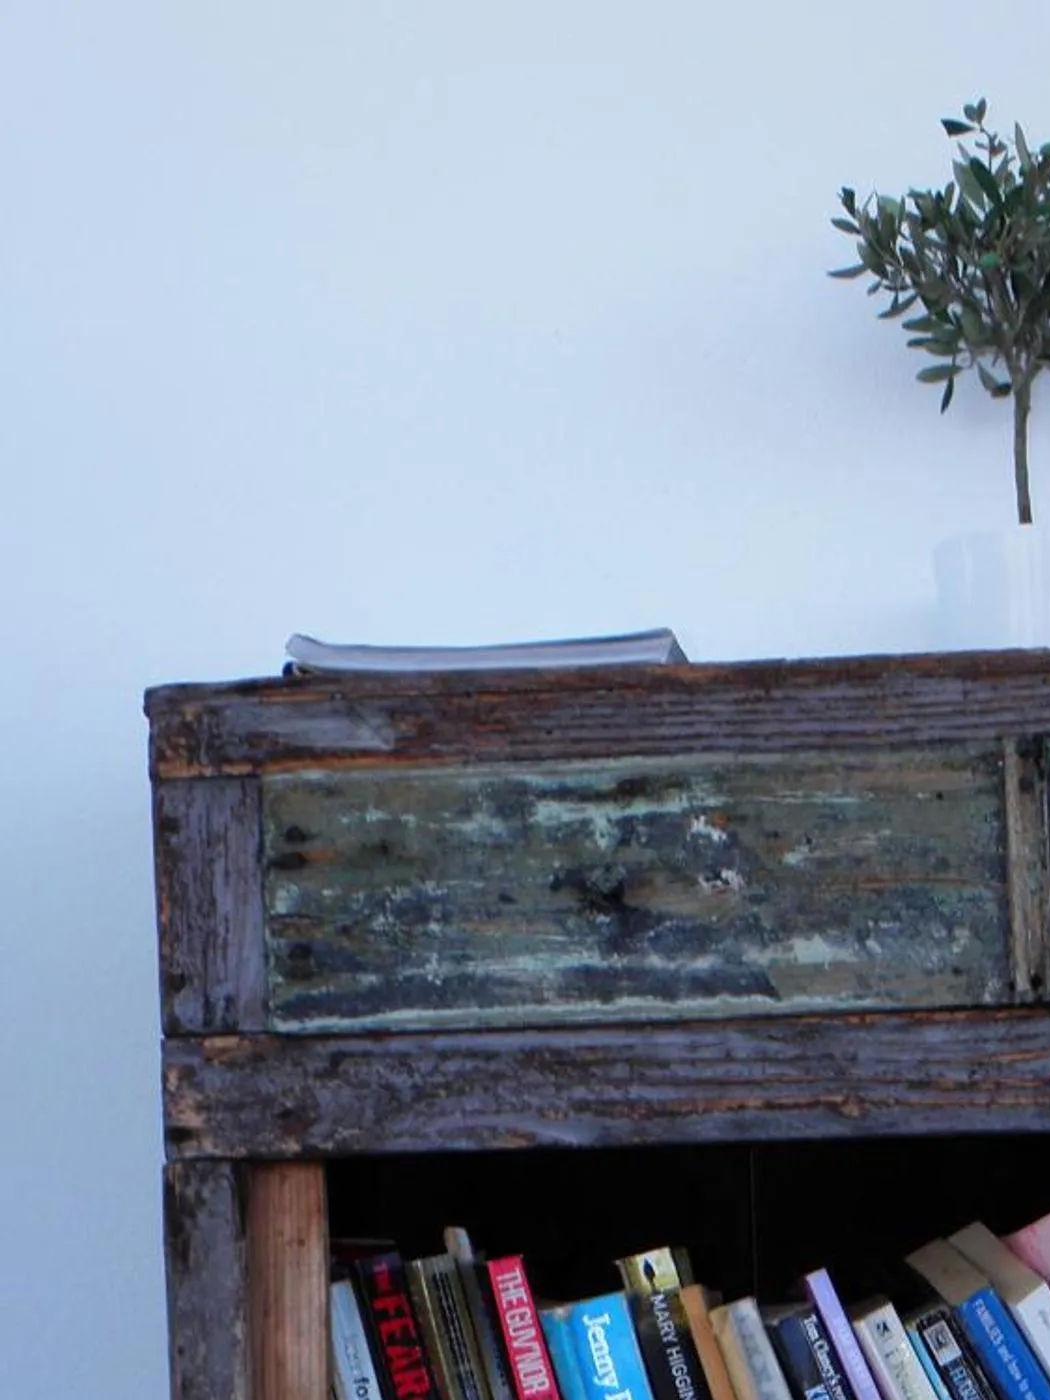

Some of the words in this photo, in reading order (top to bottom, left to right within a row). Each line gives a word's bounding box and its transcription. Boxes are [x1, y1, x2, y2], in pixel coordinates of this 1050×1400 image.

[496, 1267, 528, 1309] THE
[651, 1294, 679, 1344] MARY
[373, 1293, 430, 1400] FEAR
[504, 1306, 550, 1395] GUV'NOR
[582, 1312, 620, 1389] Jenny
[803, 1313, 820, 1343] Tom
[815, 1340, 841, 1389] Clancy's
